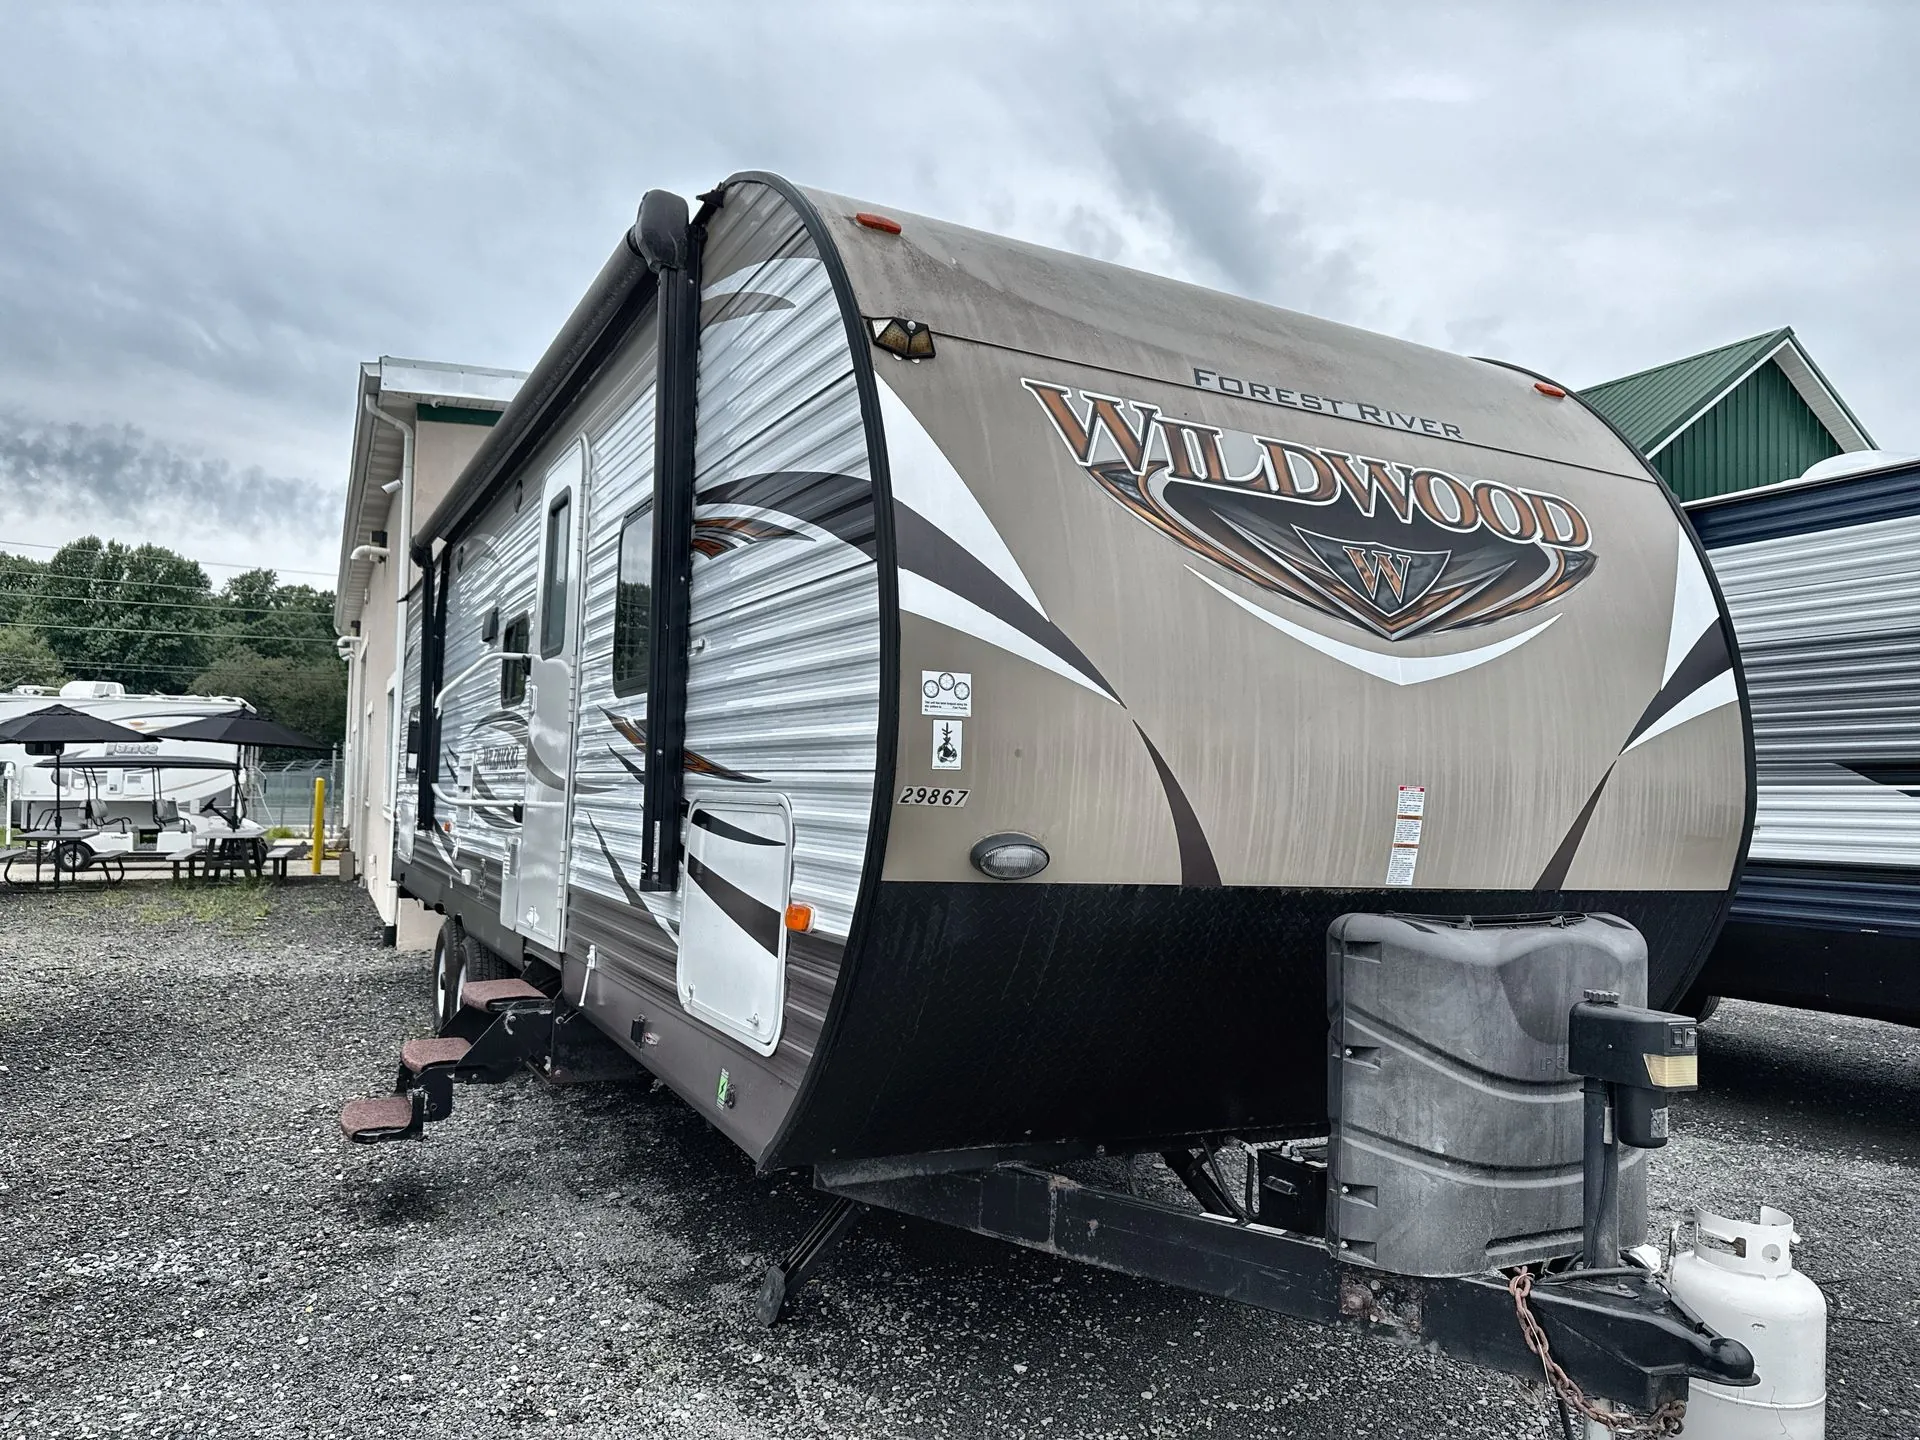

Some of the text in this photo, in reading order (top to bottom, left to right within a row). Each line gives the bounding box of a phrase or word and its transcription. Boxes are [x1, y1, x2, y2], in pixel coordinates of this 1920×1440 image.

[1193, 367, 1465, 440] FOREST RIVER
[1020, 377, 1593, 550] WILDWOOD
[1341, 543, 1413, 604] W
[900, 787, 969, 806] 29867
